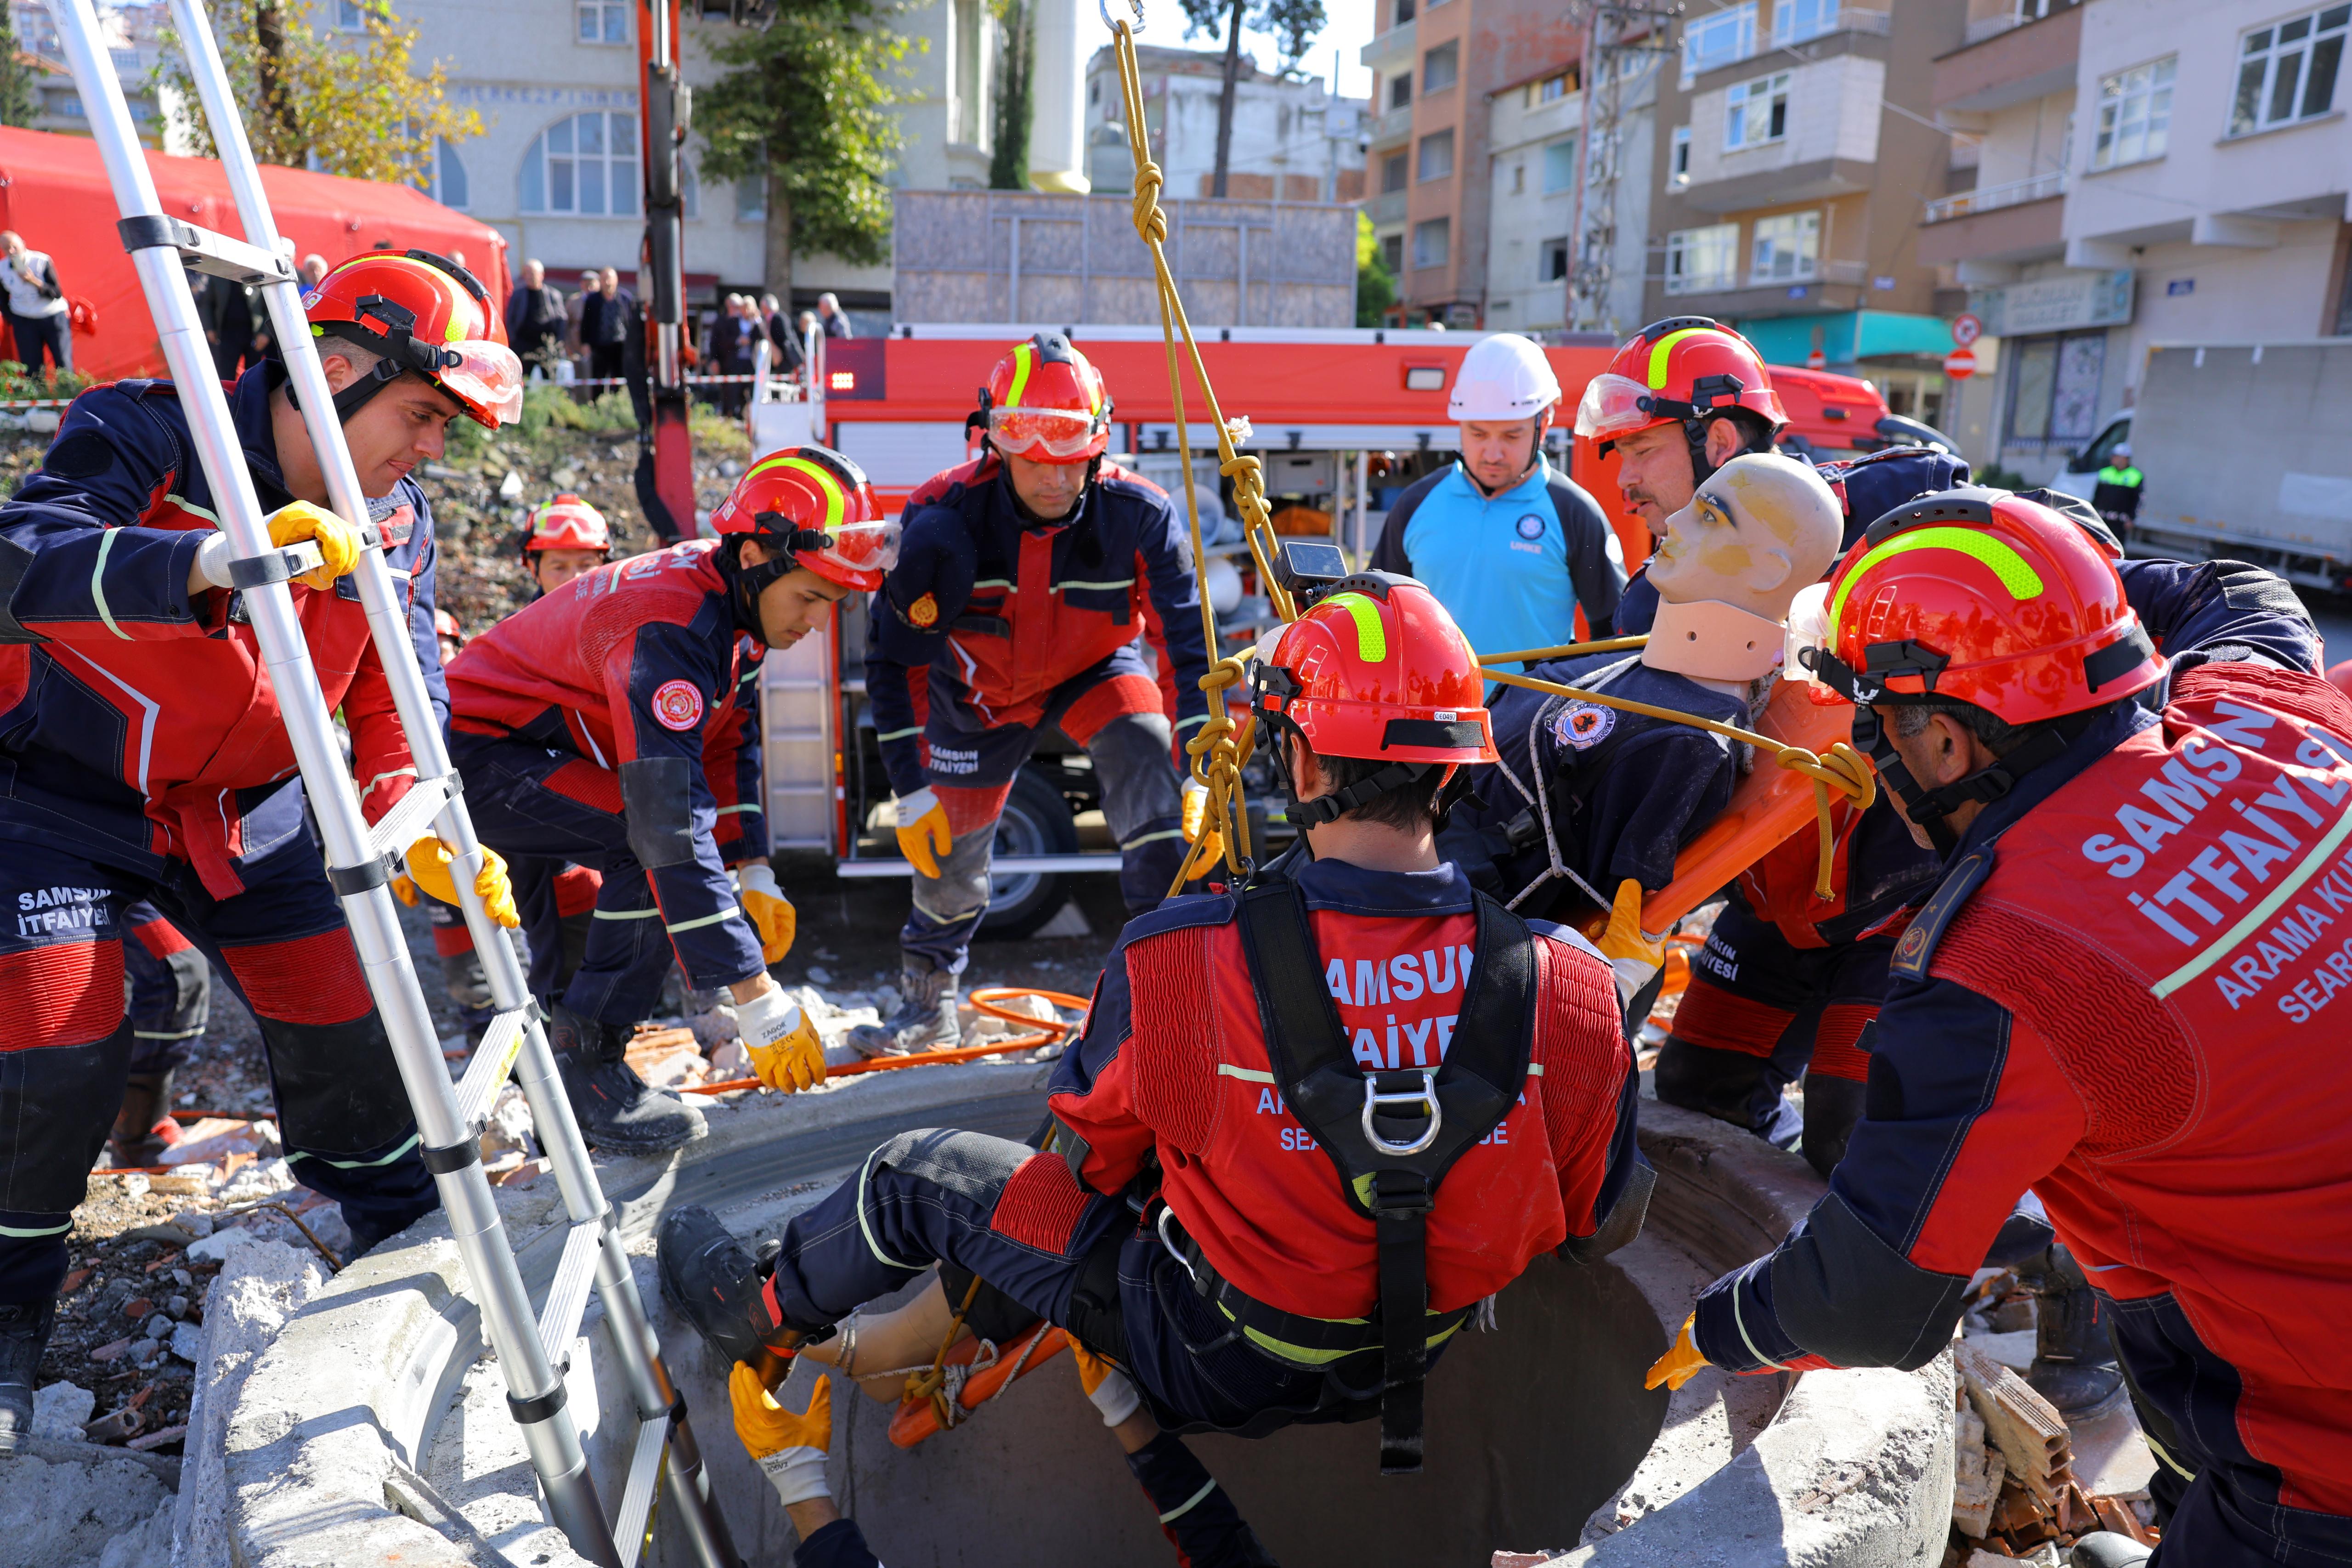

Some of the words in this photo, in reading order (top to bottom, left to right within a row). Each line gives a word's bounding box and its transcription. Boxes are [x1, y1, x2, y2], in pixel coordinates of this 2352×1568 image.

[929, 743, 978, 761] SAMSUN
[18, 886, 111, 911] SAMSUN
[17, 903, 111, 936] İTFAİYESİ
[2214, 903, 2334, 1010] ARAMA
[2312, 848, 2352, 914] KU
[762, 1021, 786, 1039] ZAGOR
